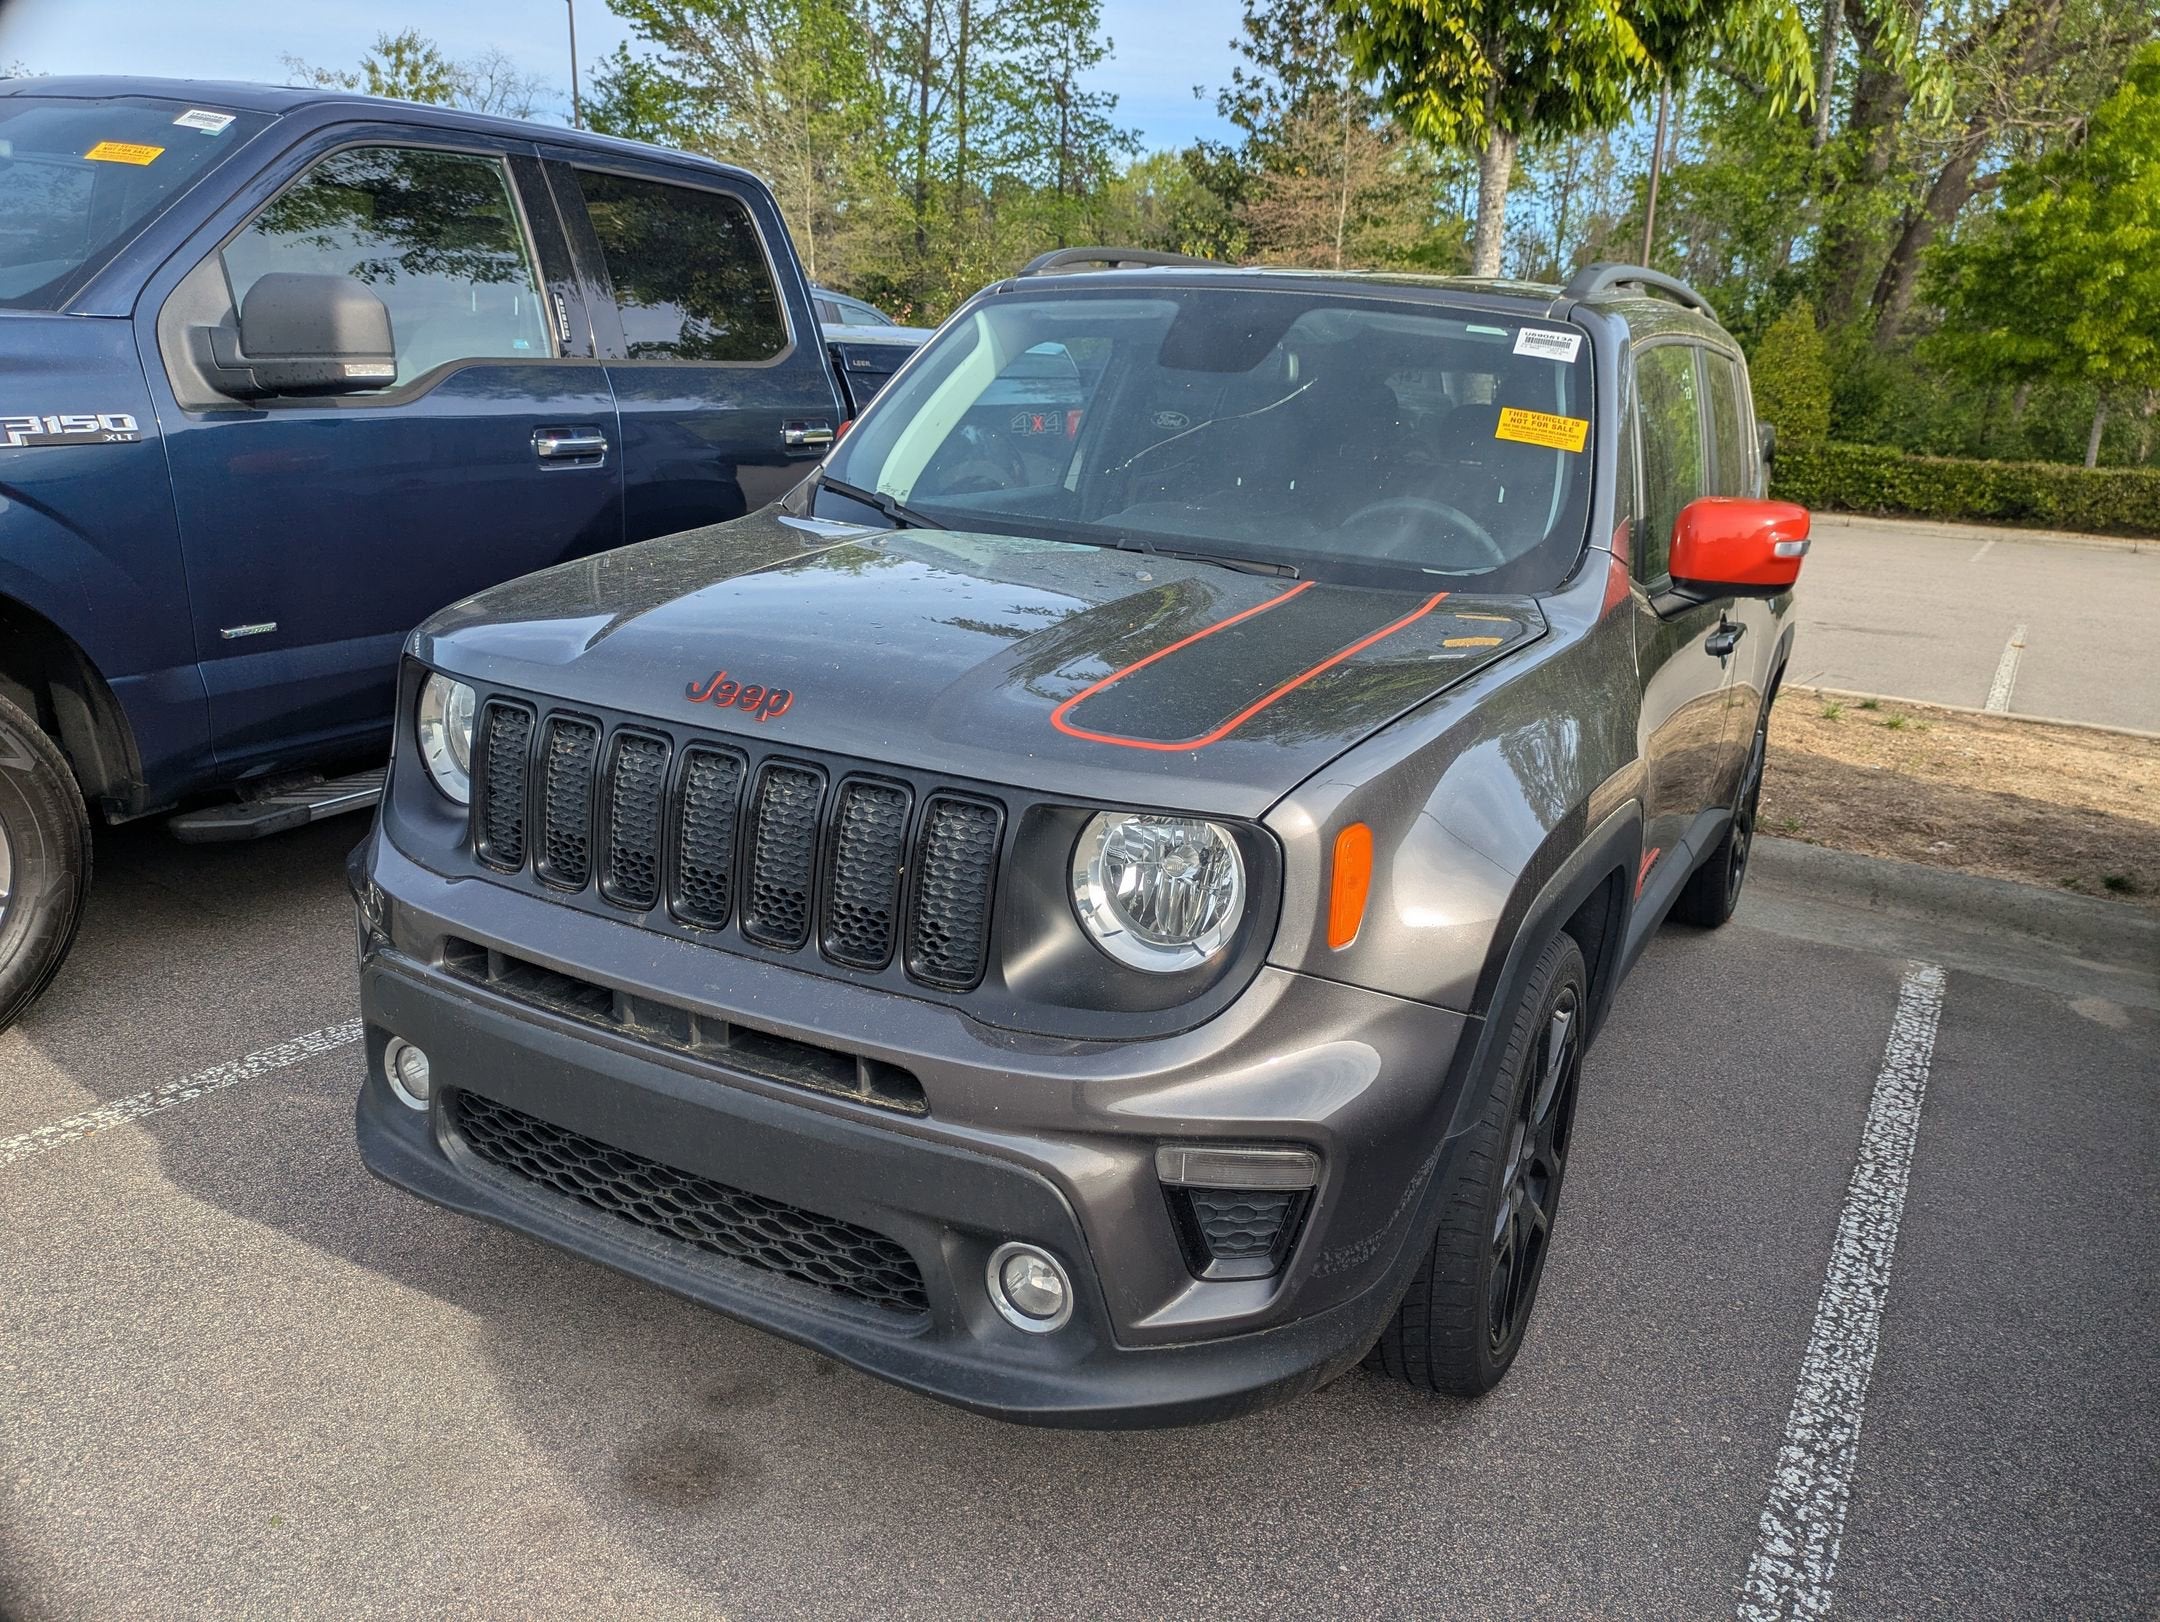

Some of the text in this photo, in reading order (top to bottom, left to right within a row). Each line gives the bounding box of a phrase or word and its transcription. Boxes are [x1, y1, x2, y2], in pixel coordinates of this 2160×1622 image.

[1155, 411, 1184, 428] Ford
[1508, 410, 1528, 419] THIS
[1531, 413, 1568, 426] VEHICLE
[1510, 417, 1574, 433] NOT FOR SALE
[104, 433, 135, 441] XLT
[685, 670, 794, 722] Jeep
